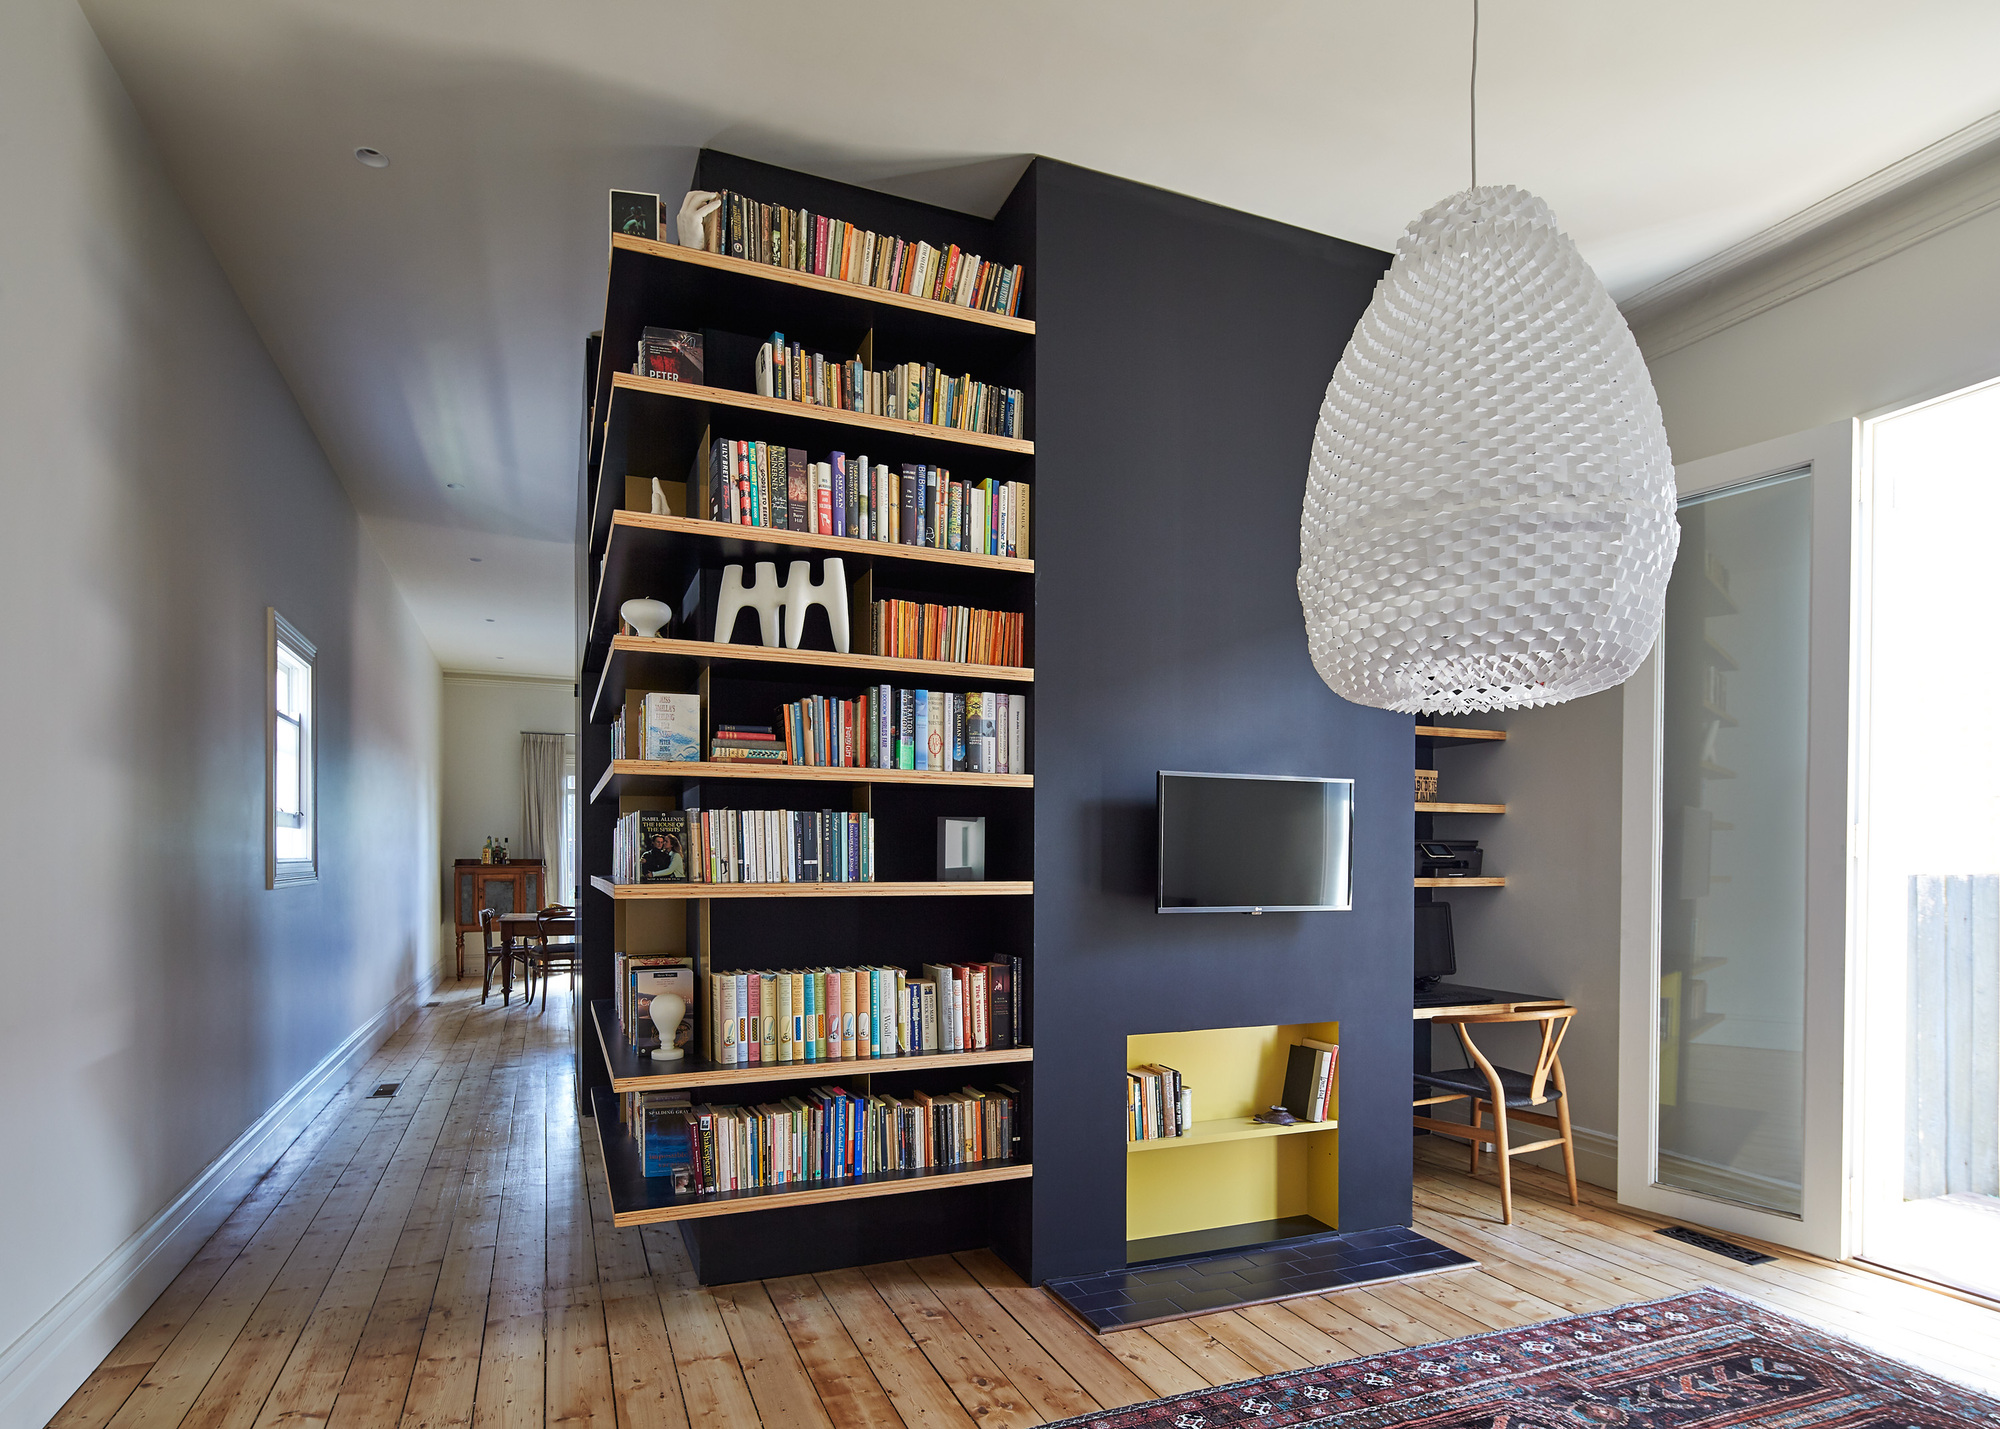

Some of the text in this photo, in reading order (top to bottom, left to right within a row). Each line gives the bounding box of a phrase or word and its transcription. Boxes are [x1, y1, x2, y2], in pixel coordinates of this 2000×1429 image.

[918, 256, 926, 274] SHARPE
[649, 369, 679, 381] PETER
[702, 1131, 711, 1176] Shakespeare
